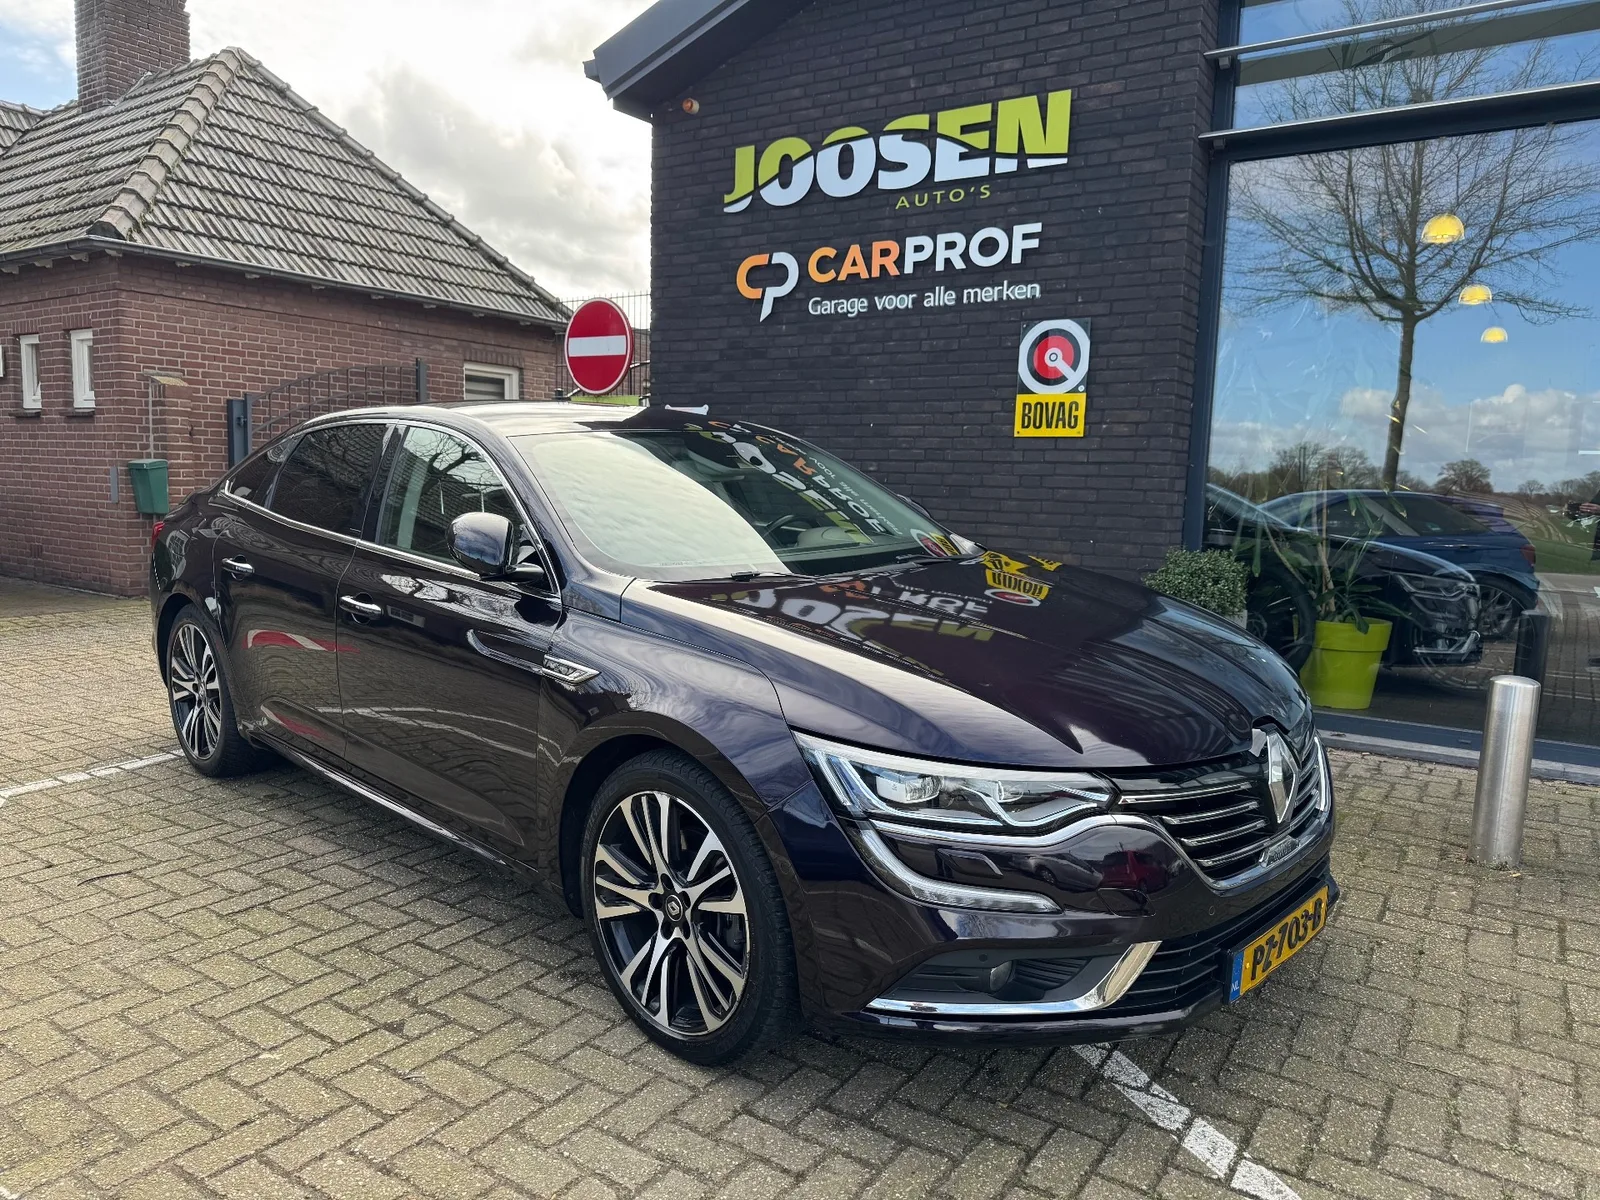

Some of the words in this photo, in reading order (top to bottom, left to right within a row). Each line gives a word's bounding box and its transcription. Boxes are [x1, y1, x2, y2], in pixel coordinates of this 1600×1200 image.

[723, 89, 1072, 213] JOOSEN
[895, 184, 991, 210] AUTO'S
[807, 222, 1043, 283] CARPROF
[808, 295, 868, 318] Garage
[875, 290, 917, 310] voor
[923, 286, 956, 307] alle
[963, 280, 1041, 304] merken
[1021, 400, 1080, 429] BOVAG
